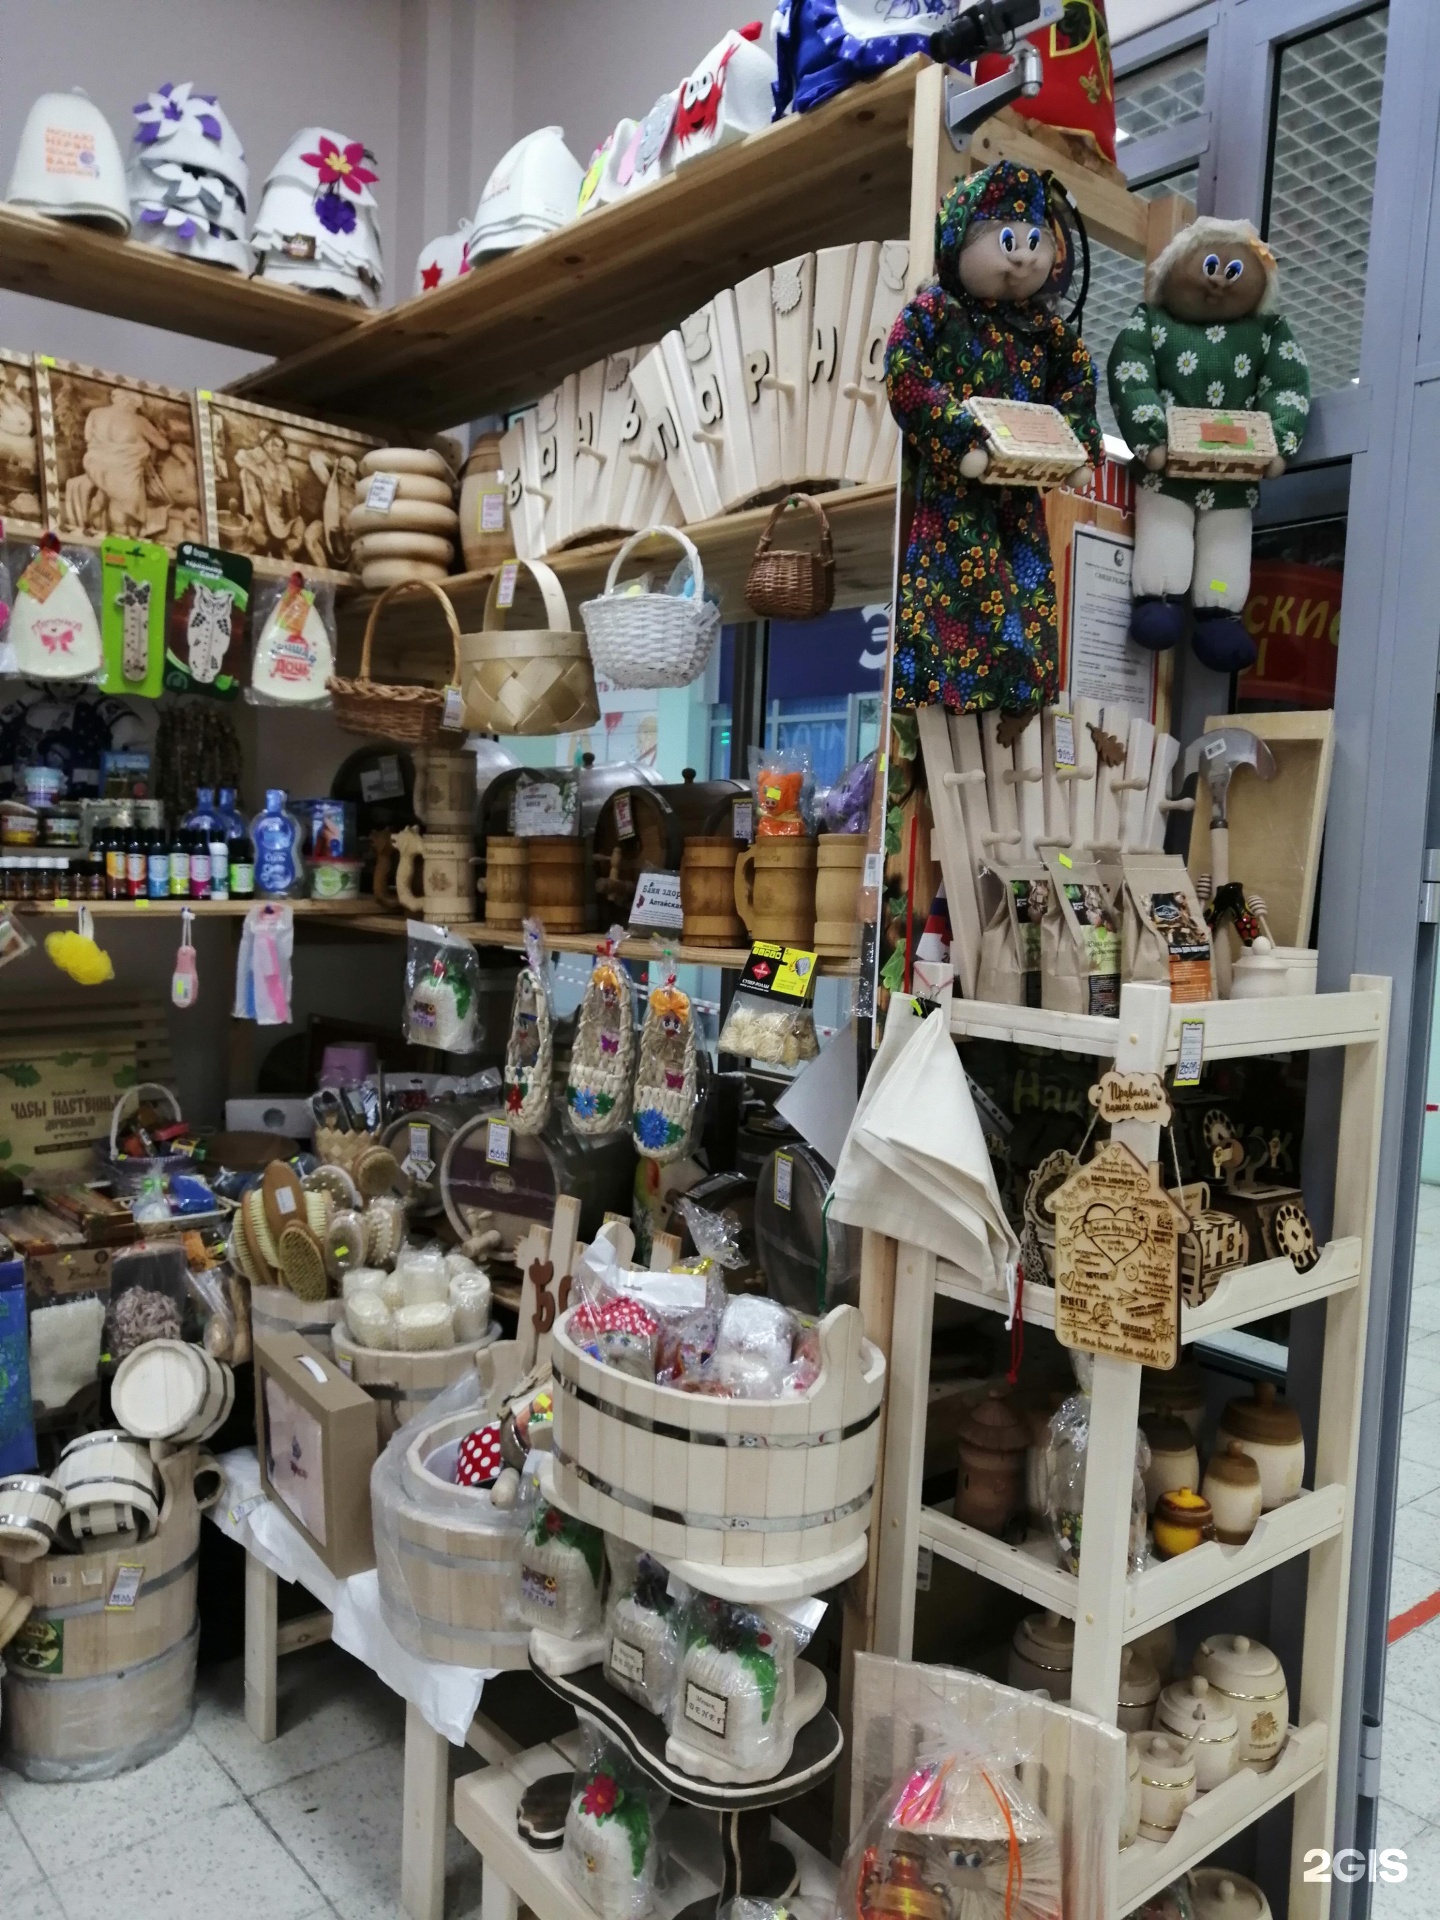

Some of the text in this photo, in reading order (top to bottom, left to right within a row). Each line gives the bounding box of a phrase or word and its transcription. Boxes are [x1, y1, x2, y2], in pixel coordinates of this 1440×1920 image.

[642, 884, 660, 896] Баня
[1108, 1081, 1150, 1102] Правила
[10, 1101, 47, 1119] ЧАСЫ
[1120, 1322, 1151, 1335] НИКОГДА
